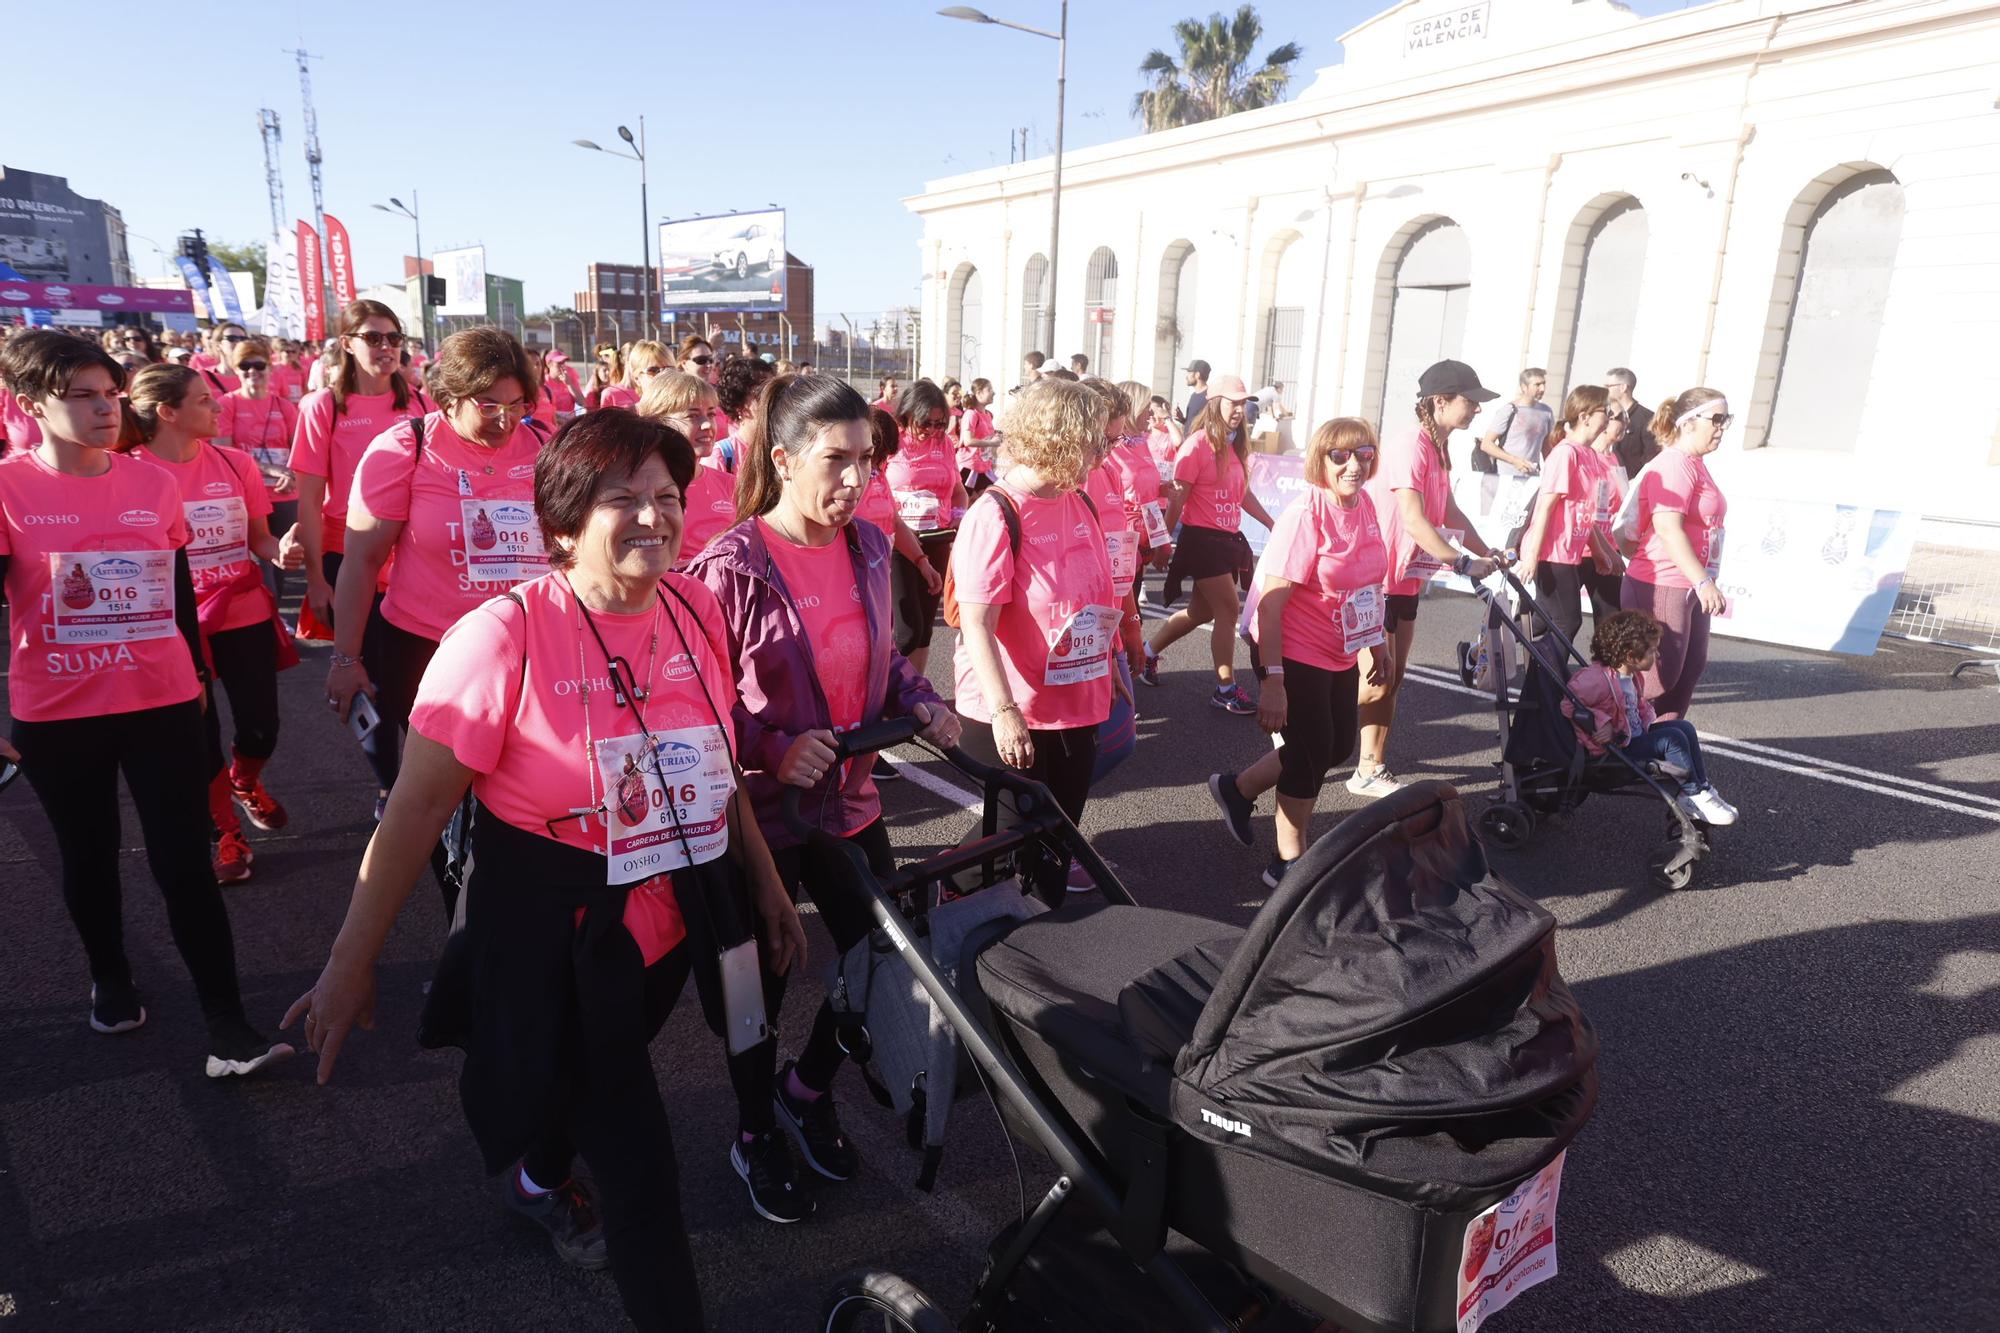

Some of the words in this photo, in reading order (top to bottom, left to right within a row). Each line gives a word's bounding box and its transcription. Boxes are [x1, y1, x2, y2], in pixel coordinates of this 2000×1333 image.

[1413, 17, 1452, 35] GRAO
[1460, 8, 1480, 24] DE
[1409, 24, 1480, 50] VALENCIA
[24, 514, 80, 525] OYSHO
[197, 525, 225, 538] 016
[499, 531, 529, 543] 016
[95, 566, 138, 577] ASTURIANA
[478, 567, 508, 575] OYSHO
[99, 586, 138, 601] 016
[108, 602, 131, 612] 1514
[1047, 600, 1070, 620] TU
[68, 628, 108, 638] OYSHO
[1073, 634, 1094, 648] 016
[47, 643, 134, 674] SUMA
[648, 755, 697, 770] ATURIANA
[651, 784, 697, 808] 016
[626, 834, 660, 849] CARRERA
[661, 832, 671, 841] DE
[671, 829, 681, 839] LA
[682, 825, 711, 836] MUJER
[623, 853, 661, 872] OYSHO
[883, 918, 907, 951] THULE
[1201, 1108, 1251, 1138] THULE
[1494, 1209, 1530, 1250] 016
